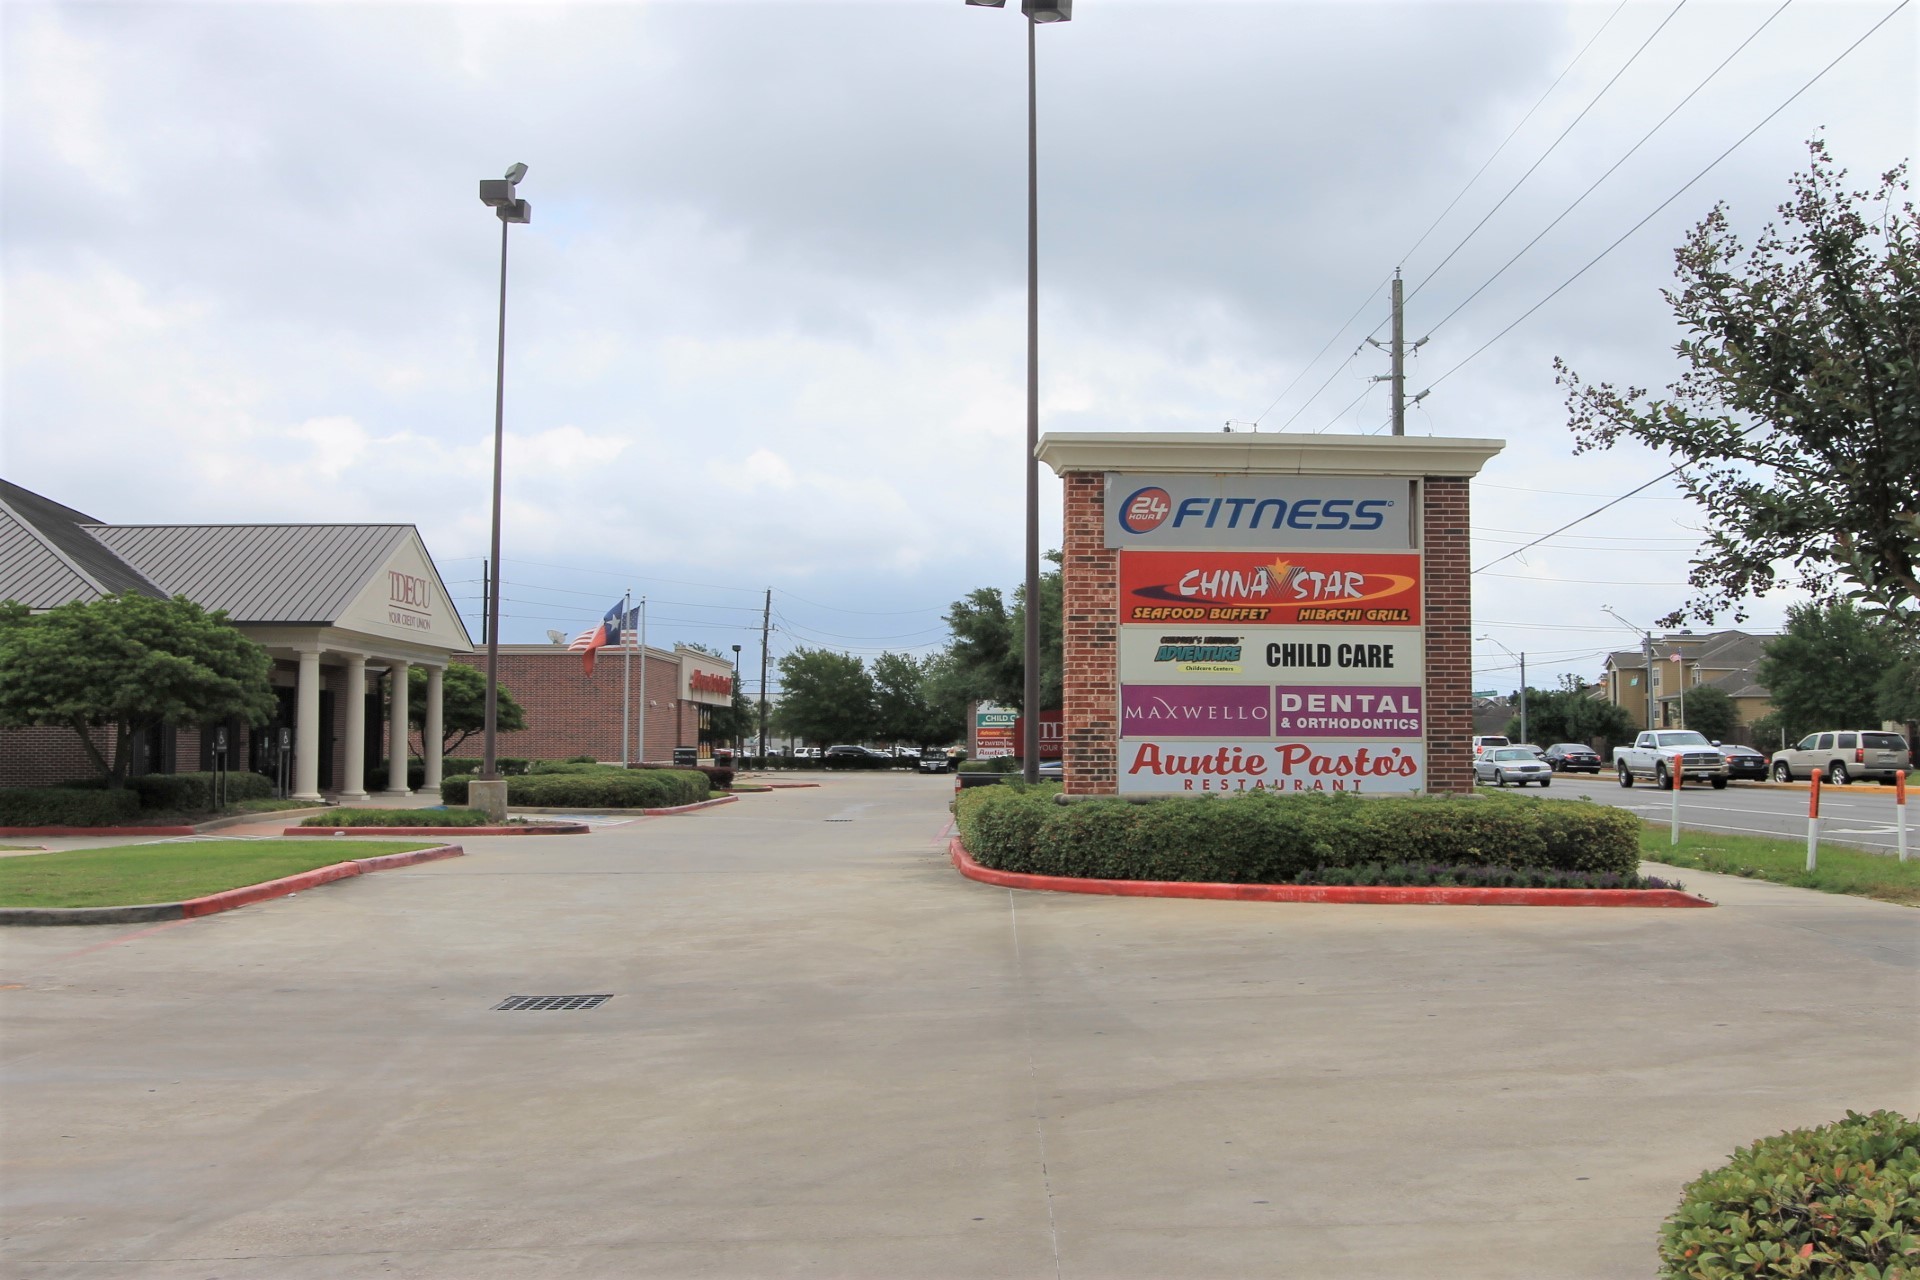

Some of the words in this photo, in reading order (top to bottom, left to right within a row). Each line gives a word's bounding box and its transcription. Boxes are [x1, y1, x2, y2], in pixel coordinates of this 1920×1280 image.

[1131, 497, 1168, 520] 24
[1172, 498, 1387, 530] FITNESS
[388, 570, 431, 609] TDECU
[1179, 569, 1268, 599] CHINA
[1292, 571, 1364, 599] STAR
[1132, 607, 1206, 620] SEAFOOD
[1209, 608, 1269, 620] BUFFET
[1298, 609, 1362, 621] HIBACHI
[1366, 609, 1409, 622] GRILL
[1154, 645, 1242, 662] ADVENTURE
[1266, 643, 1331, 667] CHILD
[1338, 643, 1394, 668] CARE
[1281, 694, 1419, 713] DENTAL
[1280, 717, 1291, 728] &
[1297, 717, 1419, 730] ORTHODONTICS
[1128, 743, 1268, 775] Auntie
[1274, 744, 1417, 777] Pasto's
[1184, 779, 1362, 791] RESTAURANT
